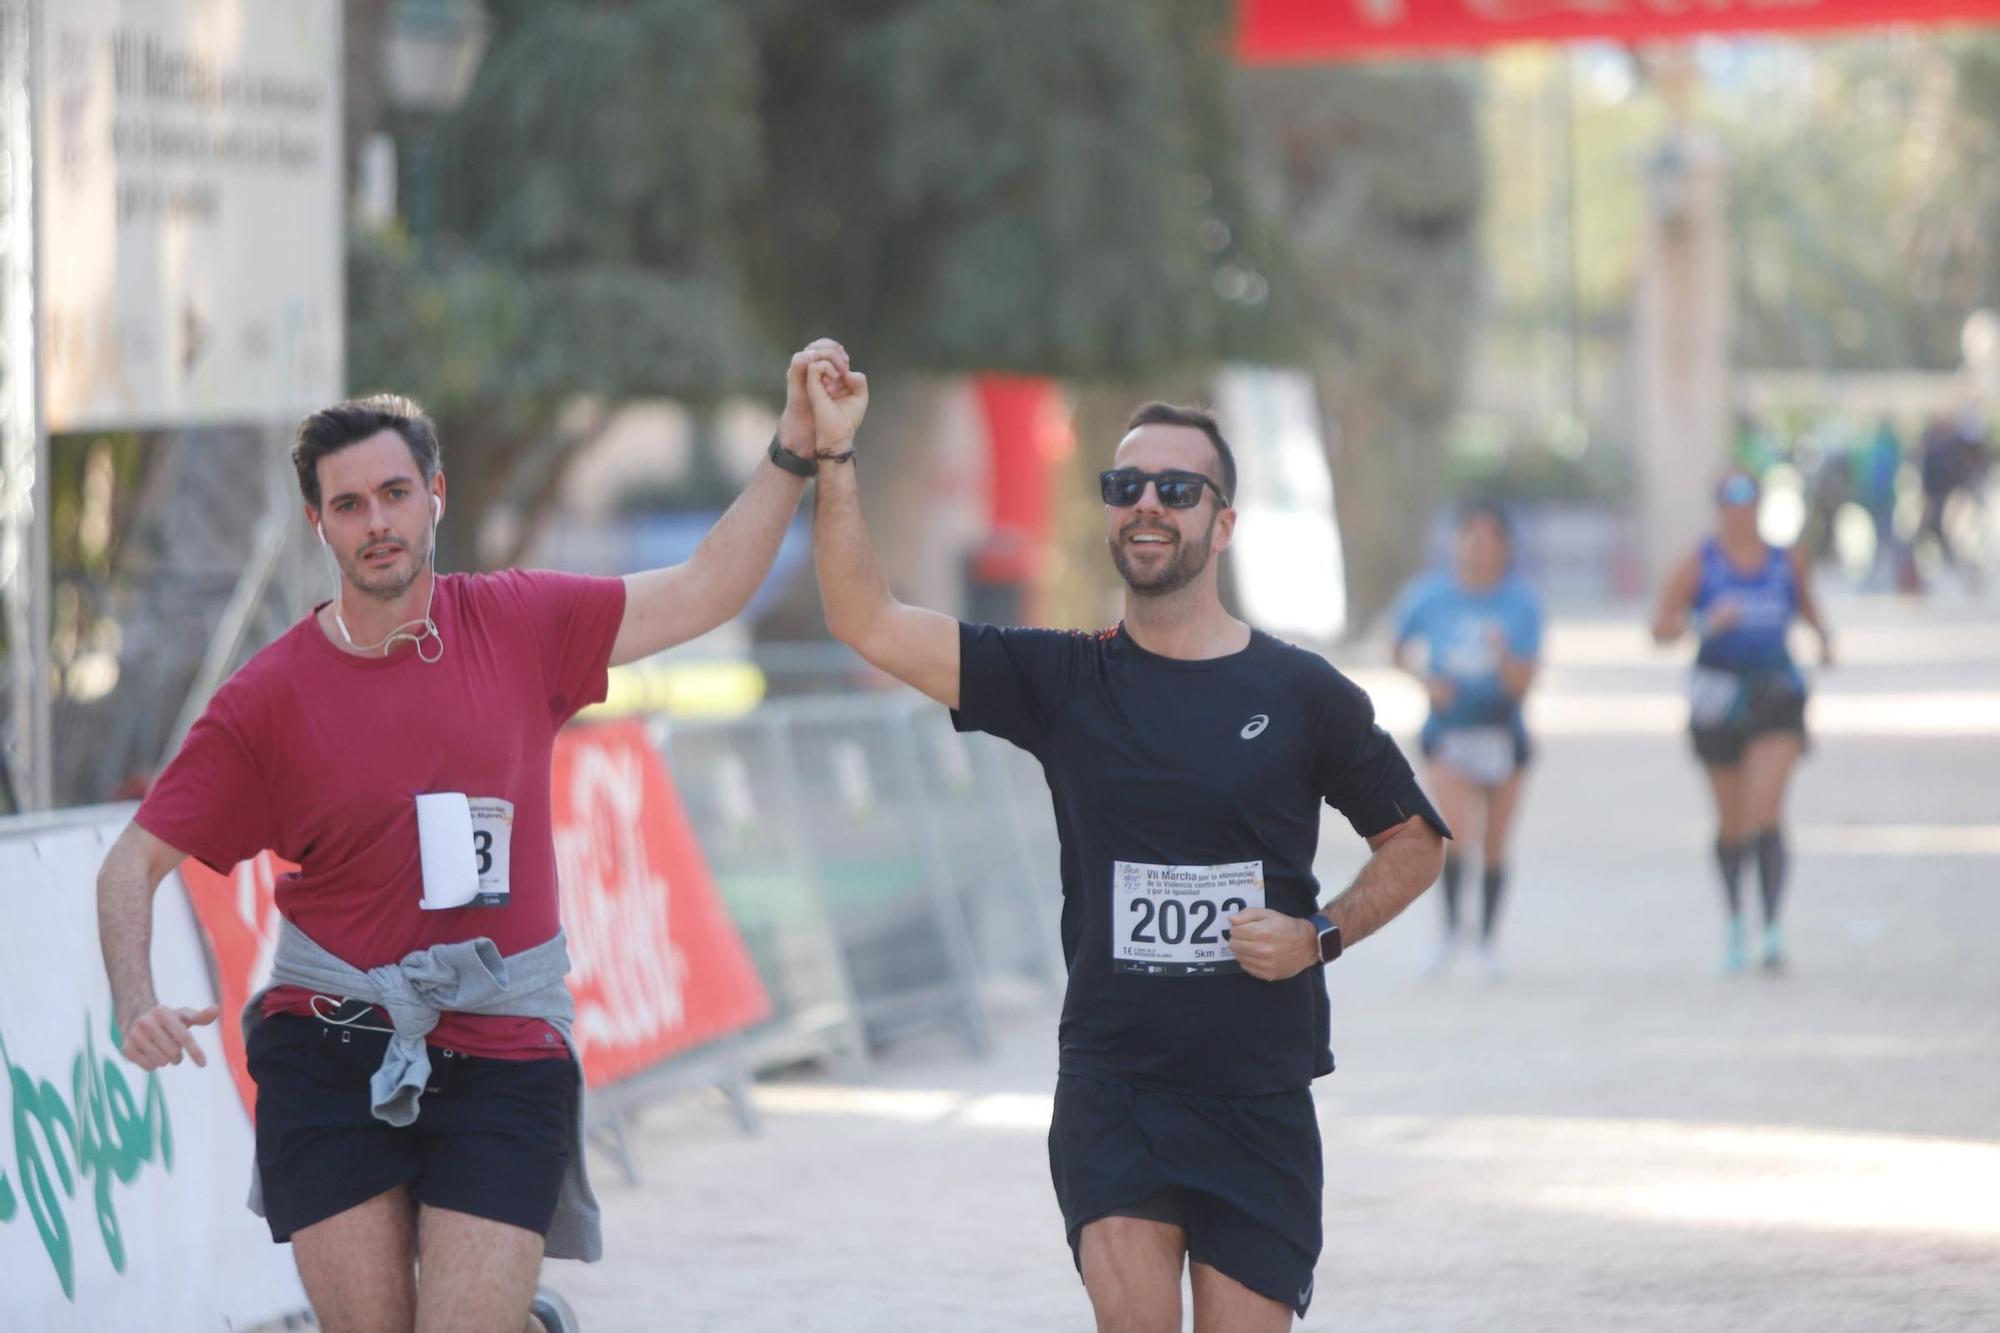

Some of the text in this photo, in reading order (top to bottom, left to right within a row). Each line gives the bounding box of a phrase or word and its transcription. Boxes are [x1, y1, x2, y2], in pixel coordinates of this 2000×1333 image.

[1147, 869, 1159, 879] VII
[1161, 870, 1197, 881] Marcha
[1195, 949, 1215, 958] 5km
